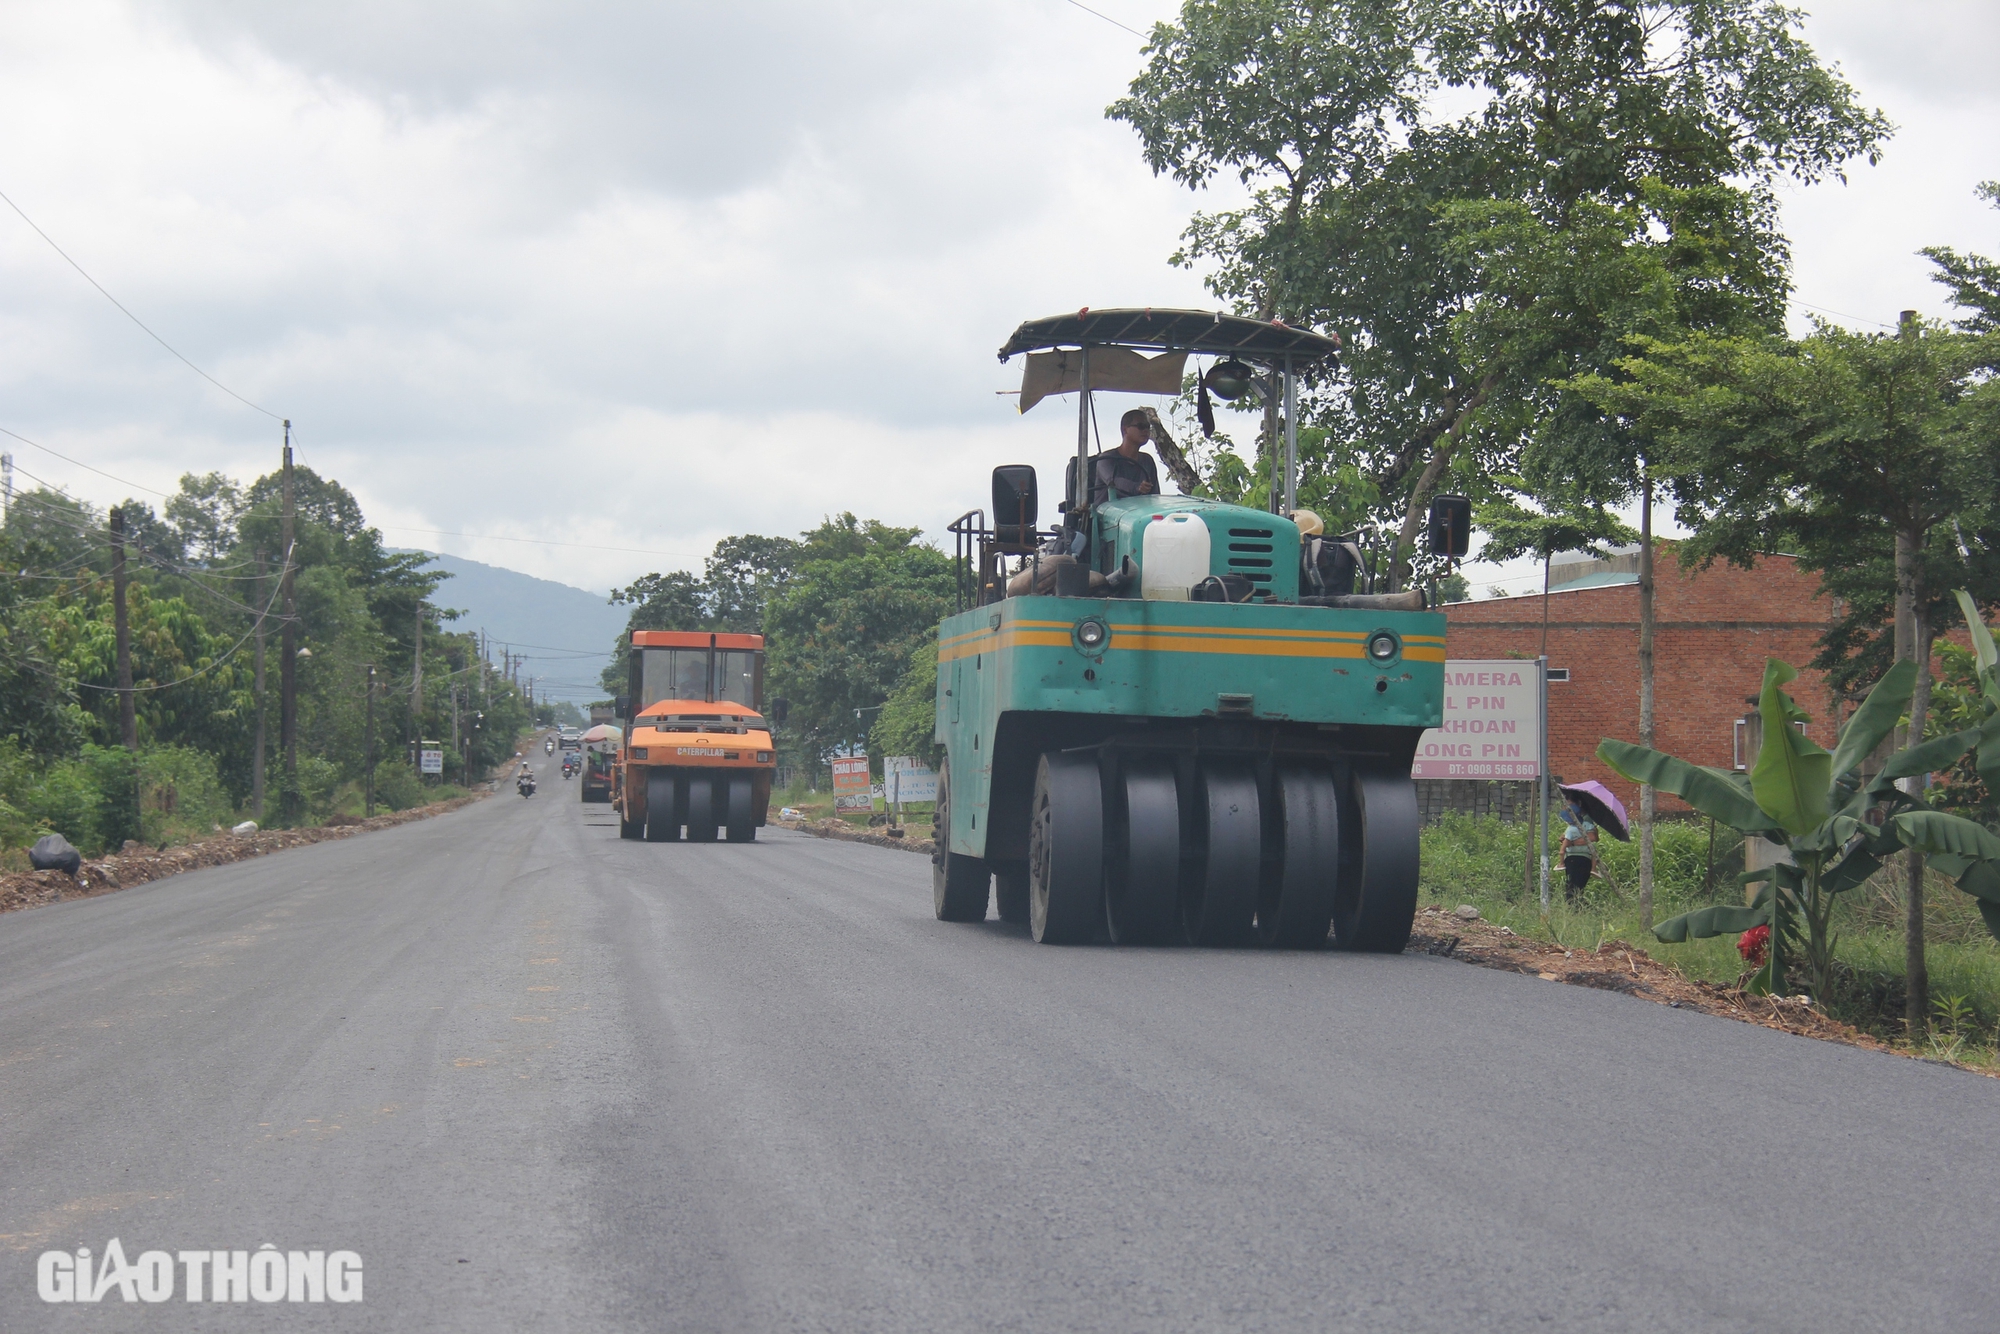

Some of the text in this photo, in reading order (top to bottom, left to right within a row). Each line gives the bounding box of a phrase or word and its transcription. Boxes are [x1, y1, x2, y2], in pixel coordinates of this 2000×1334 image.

[1442, 697, 1505, 710] L PIN
[1438, 720, 1516, 734] KHOAN
[677, 747, 725, 756] CATERPILLAR
[1482, 744, 1520, 757] PIN
[1449, 764, 1465, 774] ĐT:
[1467, 764, 1492, 774] 0908
[1494, 764, 1513, 774] 566
[1516, 764, 1534, 775] 860
